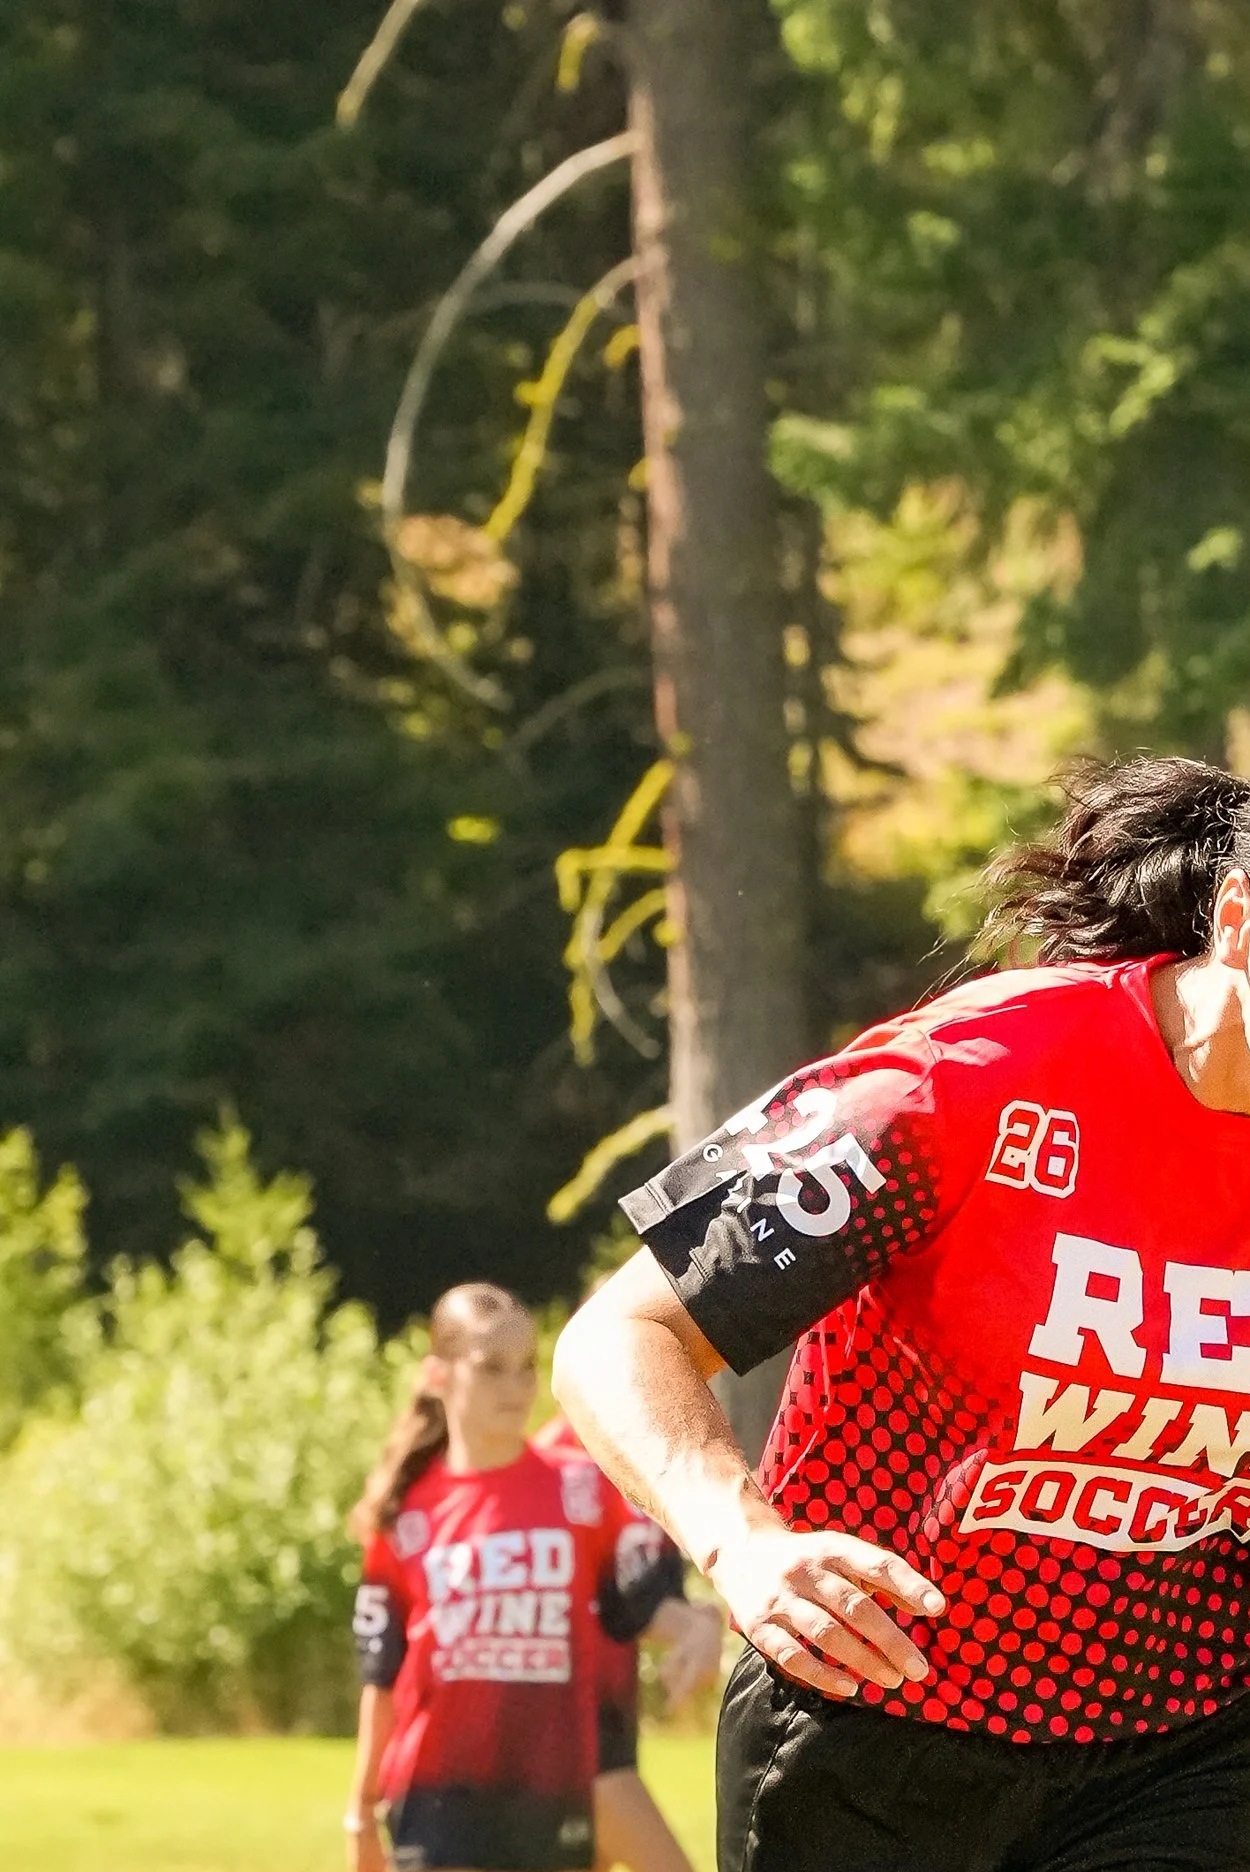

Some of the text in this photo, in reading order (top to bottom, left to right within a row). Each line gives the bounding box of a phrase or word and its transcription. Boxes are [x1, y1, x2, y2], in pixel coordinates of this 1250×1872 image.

[984, 1099, 1080, 1199] 26
[423, 1528, 575, 1601] RED
[432, 1590, 572, 1647] WINE
